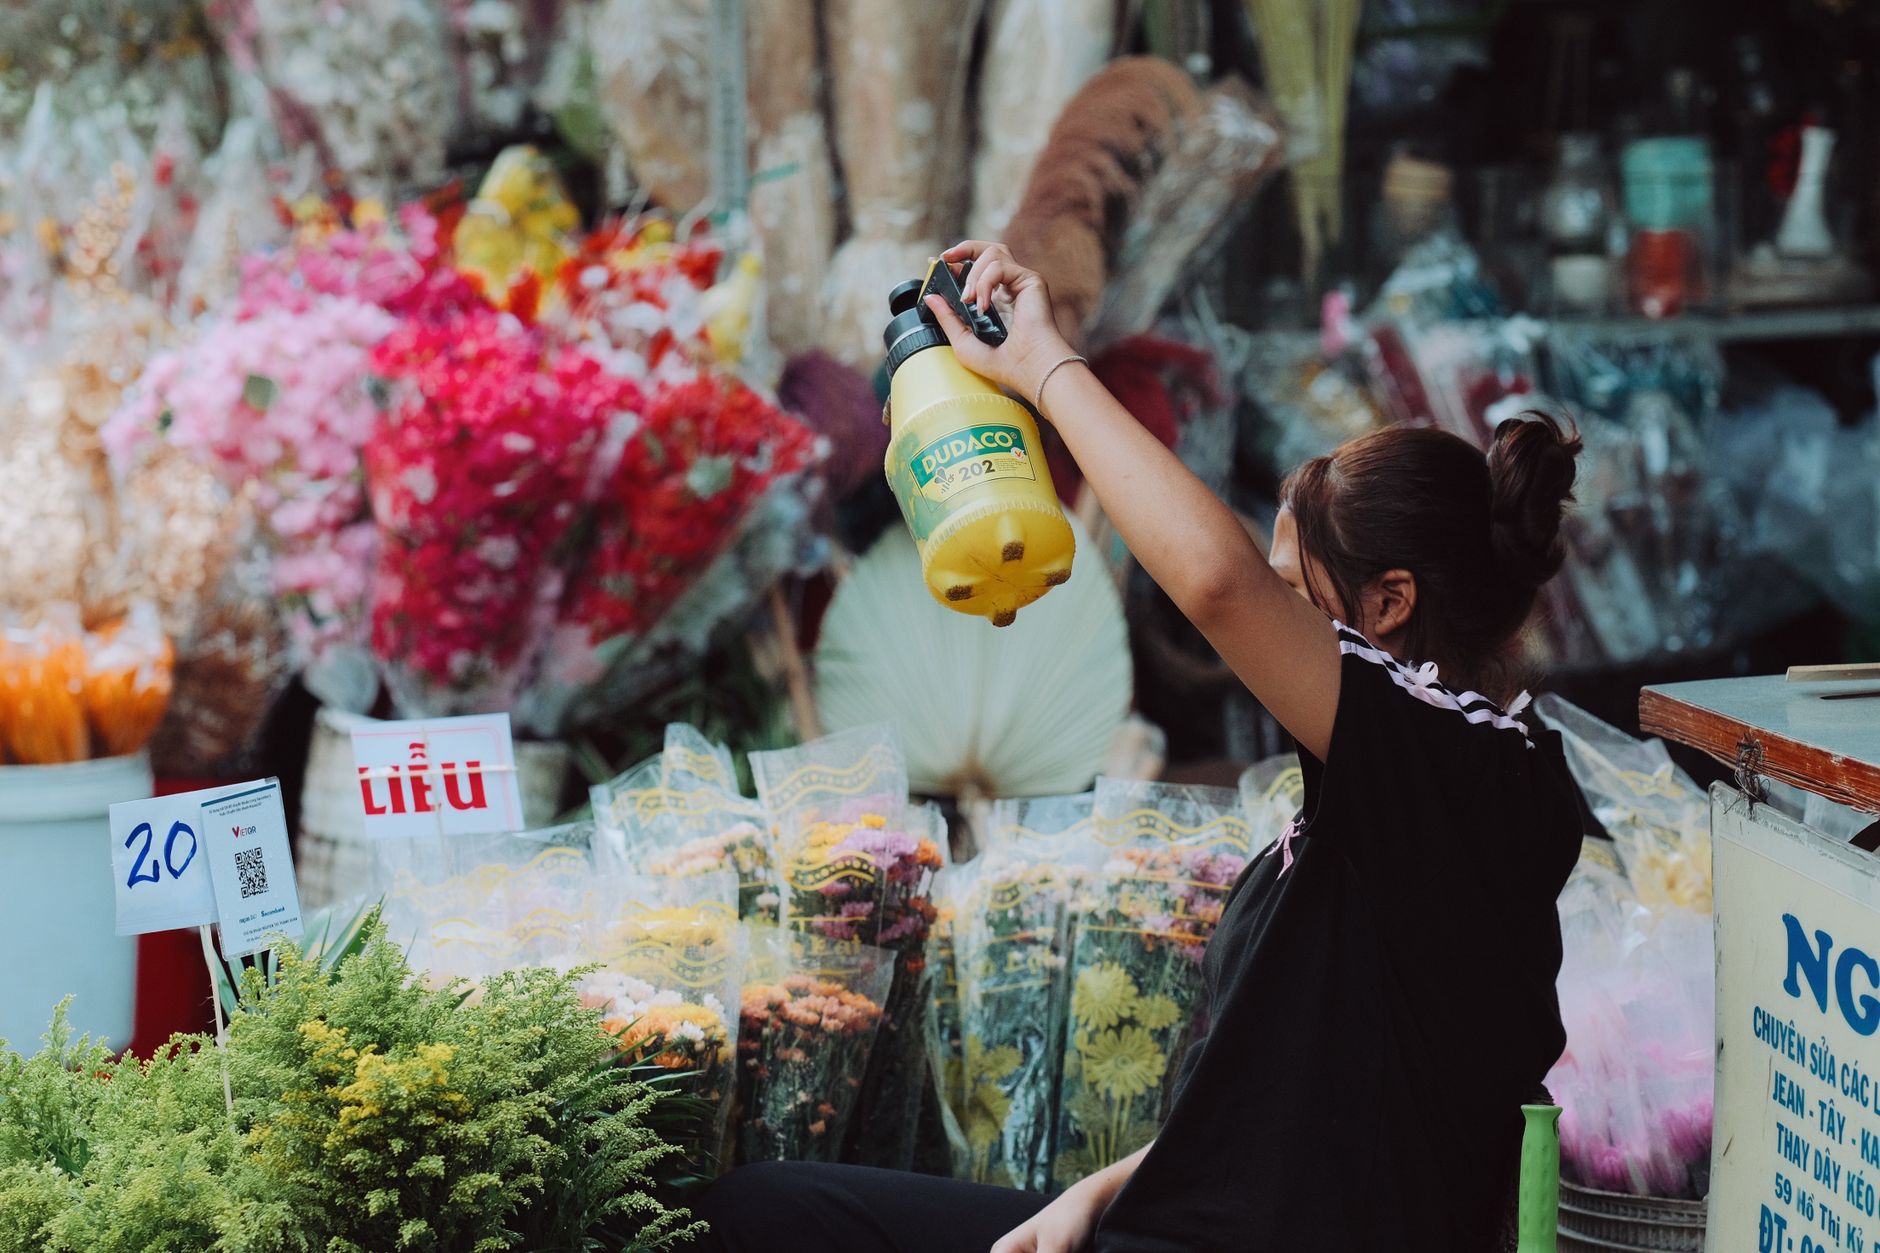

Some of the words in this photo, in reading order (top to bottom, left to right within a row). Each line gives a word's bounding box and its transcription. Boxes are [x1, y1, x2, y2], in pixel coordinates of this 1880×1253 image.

[959, 460, 995, 482] 202
[125, 820, 197, 889] 20
[1782, 912, 1880, 1036] NG
[1753, 1006, 1806, 1068] CHUYÊN
[1810, 1036, 1836, 1088] SỬA
[1841, 1060, 1870, 1108] CÁC
[1773, 1070, 1805, 1120] JEAN
[1818, 1098, 1846, 1145] TÂY
[1861, 1127, 1880, 1170] KA
[1775, 1172, 1792, 1205] 59
[1797, 1187, 1815, 1222] Hồ
[1819, 1203, 1840, 1247] Thị
[1776, 1121, 1810, 1172] THAY
[1814, 1147, 1841, 1194] DÂY
[1847, 1170, 1875, 1217] KÉO
